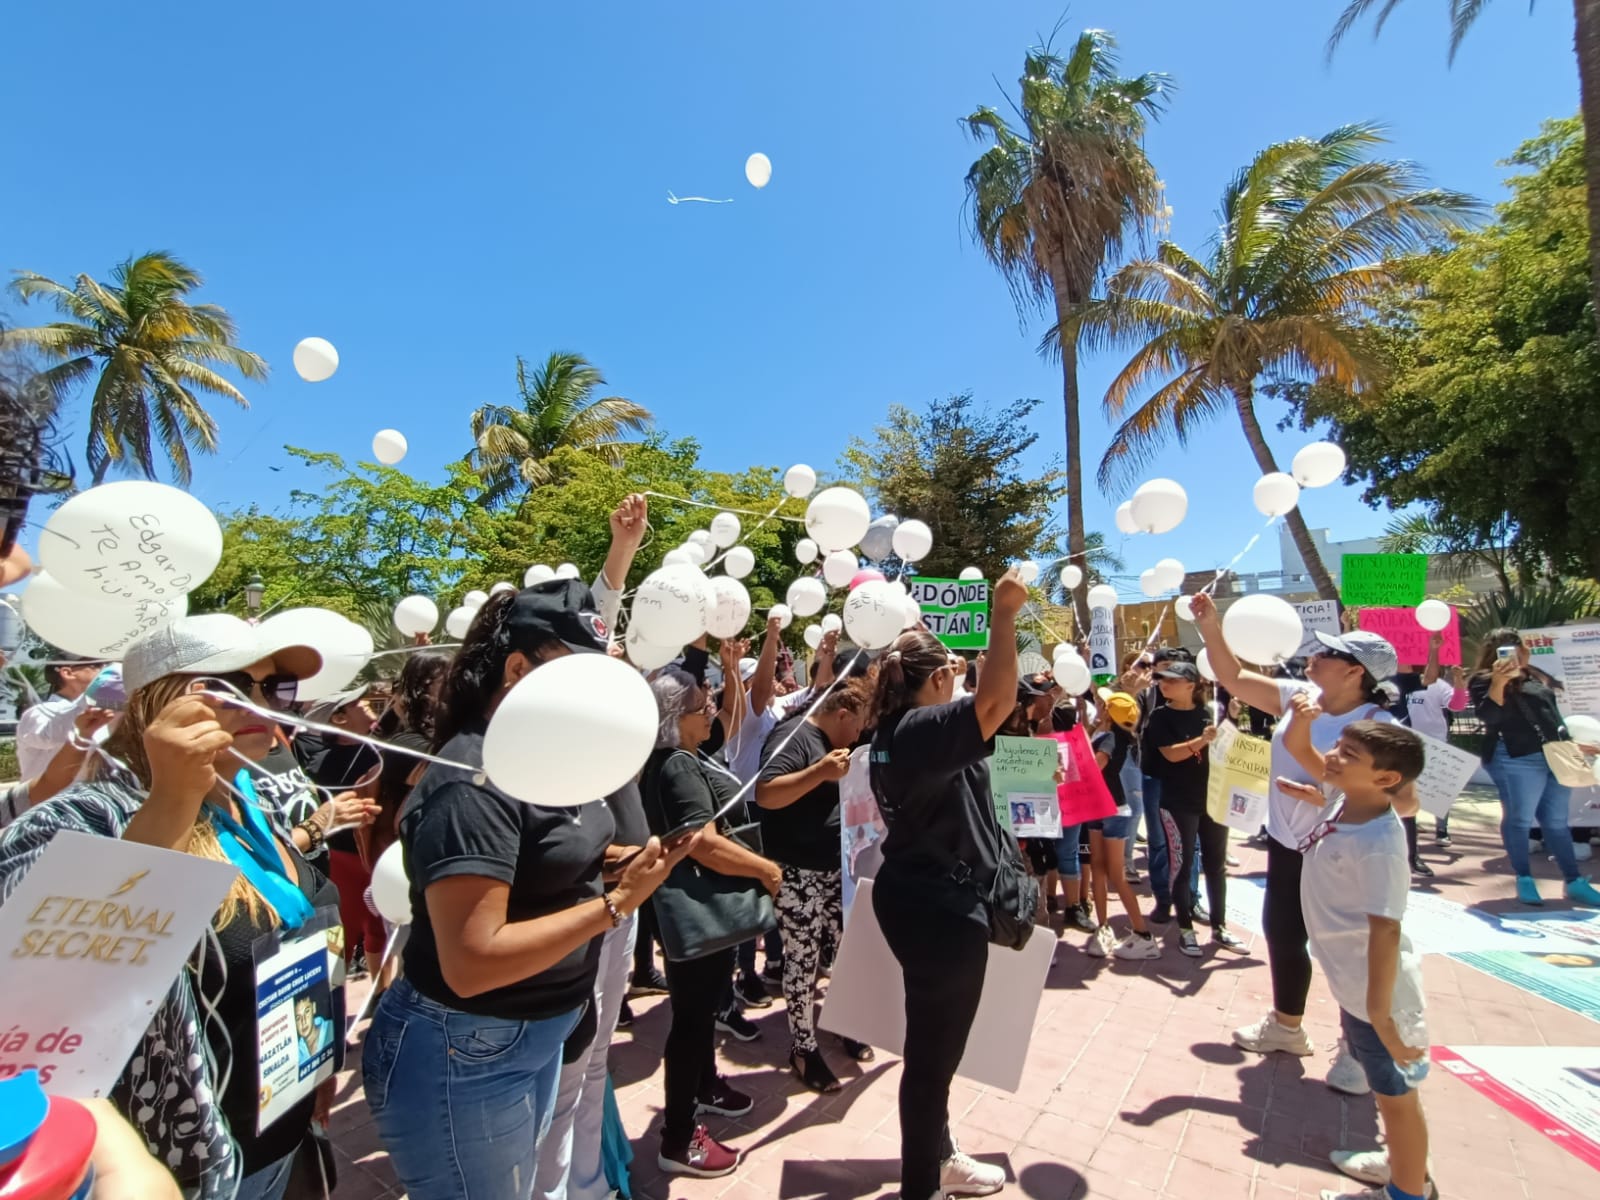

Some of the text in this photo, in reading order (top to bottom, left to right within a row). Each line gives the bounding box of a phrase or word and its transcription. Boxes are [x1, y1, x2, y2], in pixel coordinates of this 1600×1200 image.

[129, 514, 176, 574] Edgar
[119, 561, 165, 594] Amo
[911, 584, 986, 606] ¿DÓNDE
[1043, 745, 1051, 757] A
[1232, 738, 1266, 756] HASTA
[27, 896, 175, 937] ETERNAL
[11, 928, 158, 965] SECRET
[0, 1025, 83, 1054] ía de
[263, 1053, 290, 1079] SINALOA
